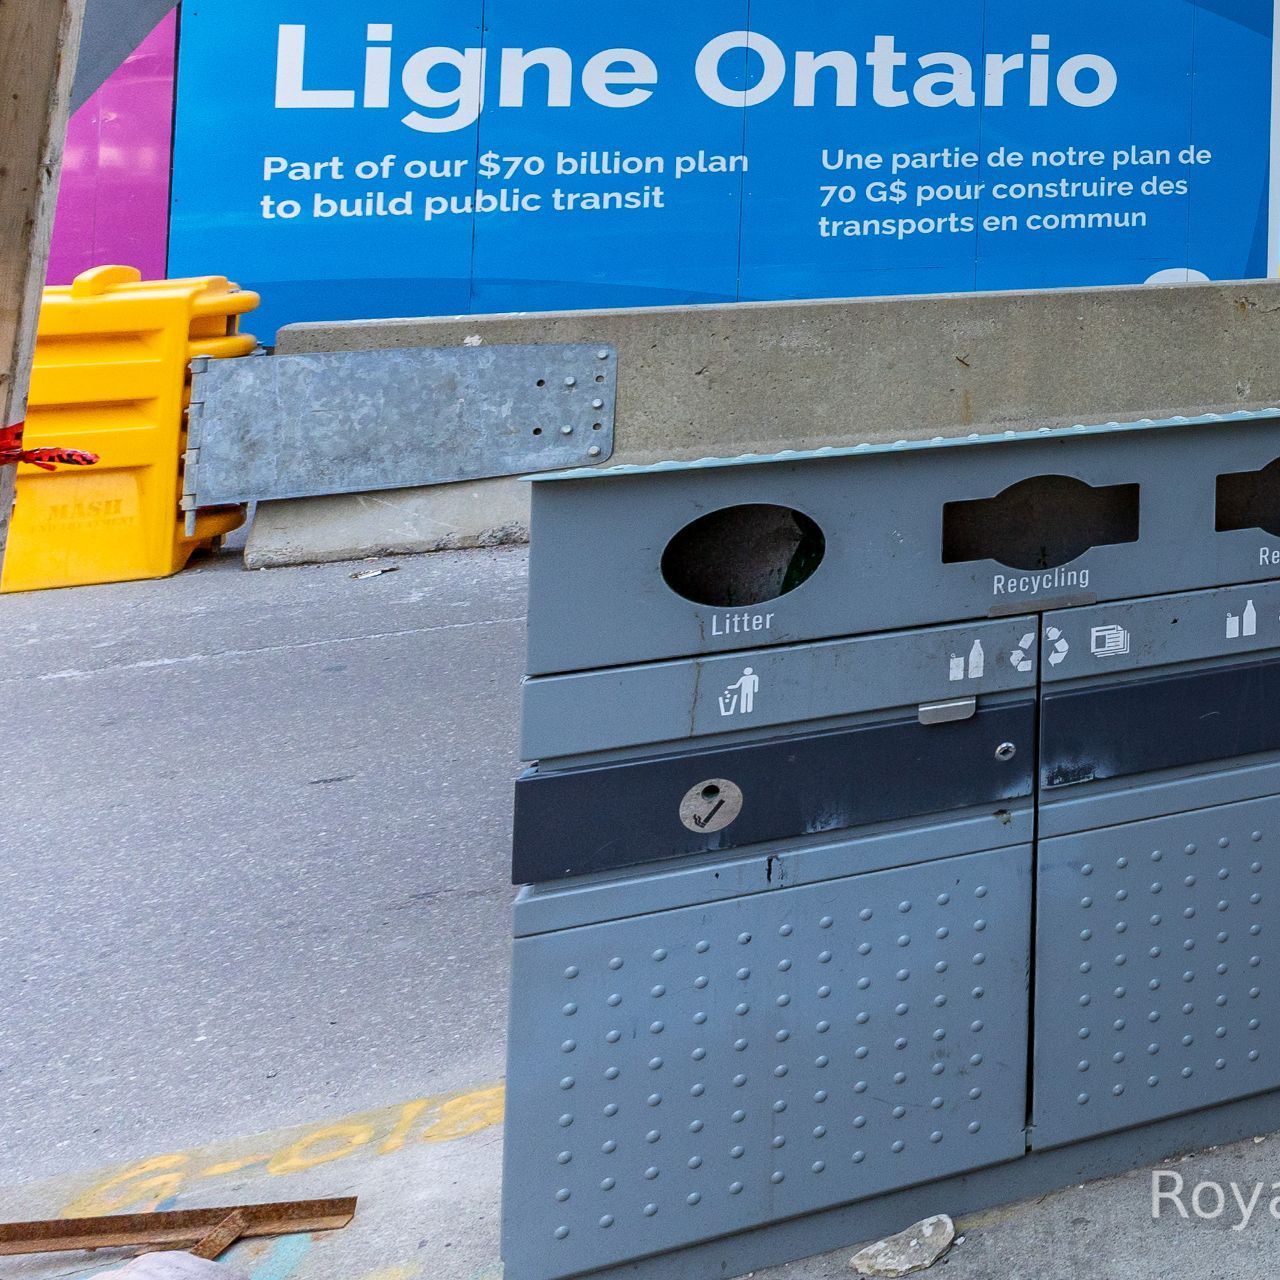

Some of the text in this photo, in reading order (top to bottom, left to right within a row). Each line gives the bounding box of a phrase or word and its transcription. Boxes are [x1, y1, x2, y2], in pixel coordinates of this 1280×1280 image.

[274, 23, 1118, 133] Ligne Ontario
[264, 150, 749, 181] Part of our $70 billion plan
[821, 143, 1212, 177] Une partie de notre plan de
[261, 184, 665, 221] to build public transit
[820, 174, 1188, 207] 70 G$ pour construire des
[818, 209, 1148, 240] transports en commun
[992, 565, 1091, 597] Recycling
[711, 609, 775, 636] Litter
